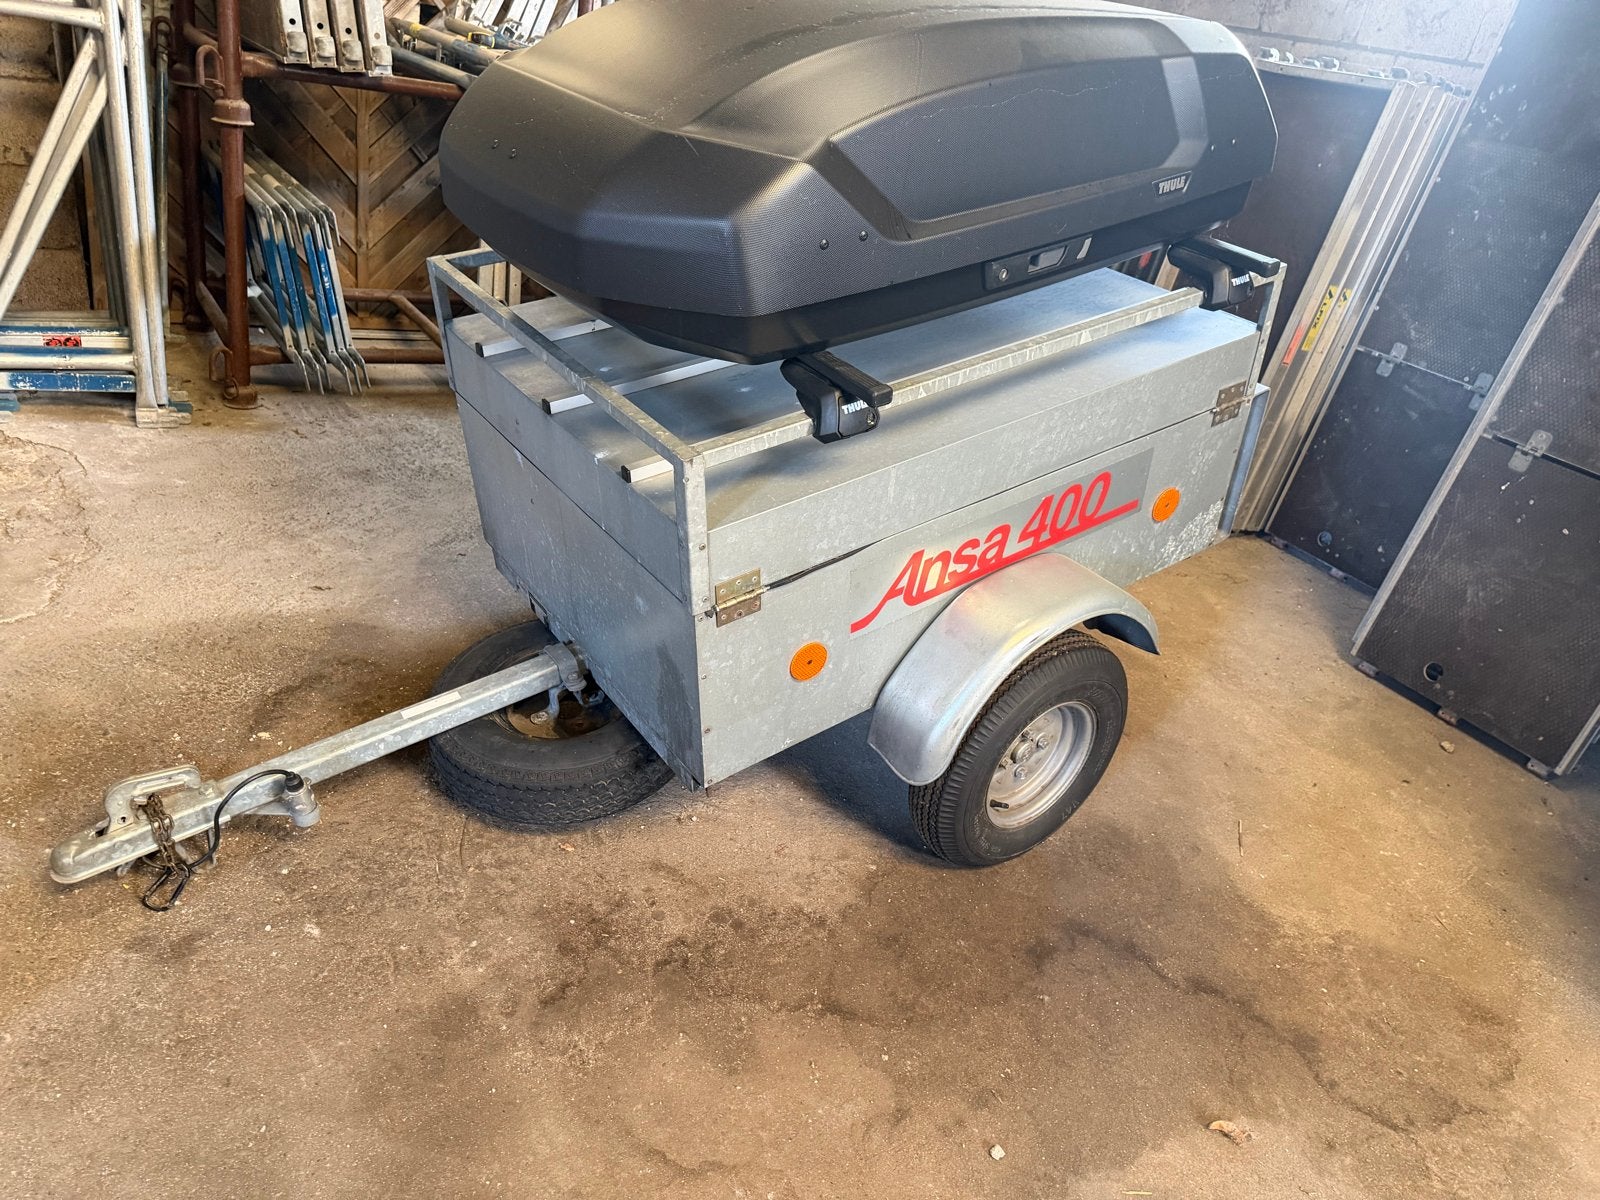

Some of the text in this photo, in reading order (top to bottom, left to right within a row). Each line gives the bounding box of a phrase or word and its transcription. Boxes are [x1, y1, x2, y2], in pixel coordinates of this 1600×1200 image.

[1158, 175, 1186, 195] THULE
[866, 471, 1112, 622] Ansa 400
